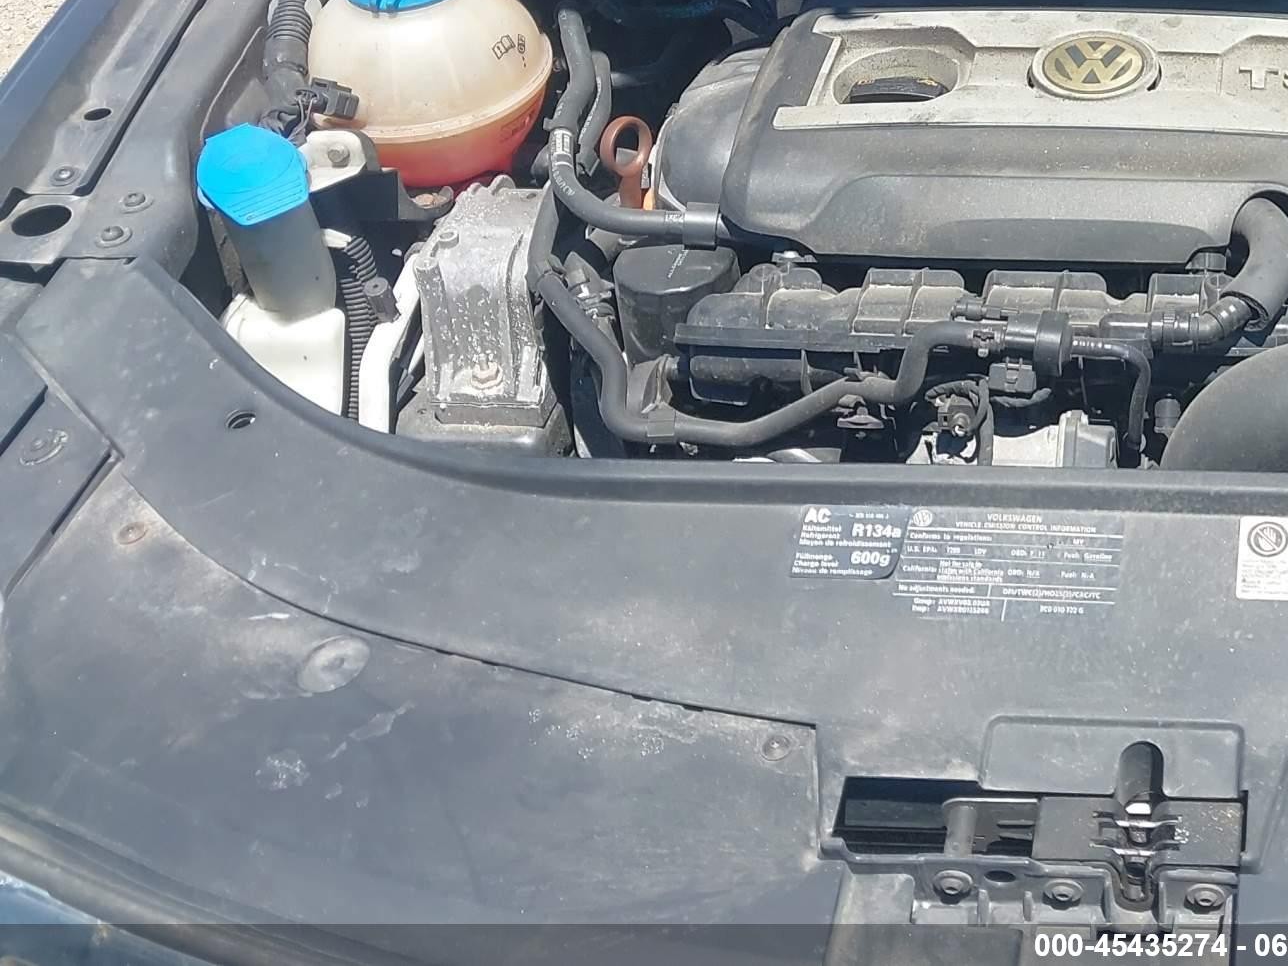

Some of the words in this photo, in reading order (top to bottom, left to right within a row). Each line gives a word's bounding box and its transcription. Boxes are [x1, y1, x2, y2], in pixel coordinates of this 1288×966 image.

[804, 507, 832, 523] AC
[987, 514, 1042, 523] VOLKSWAGEN
[852, 522, 902, 538] R134a
[984, 522, 1016, 530] EMISSION
[1050, 525, 1097, 533] INFORMATION
[851, 551, 891, 567] 600g
[909, 585, 949, 593] adjustments
